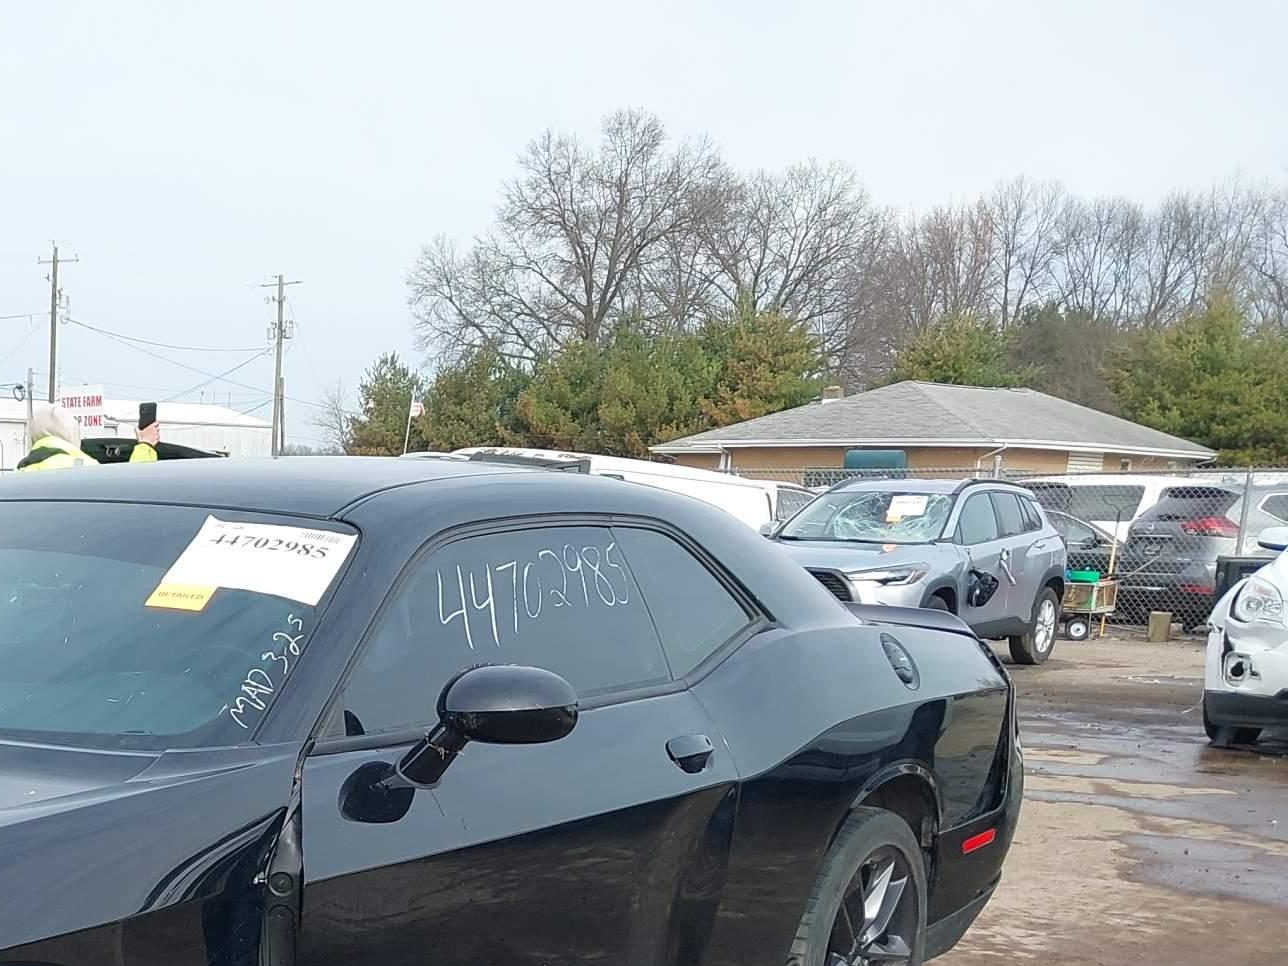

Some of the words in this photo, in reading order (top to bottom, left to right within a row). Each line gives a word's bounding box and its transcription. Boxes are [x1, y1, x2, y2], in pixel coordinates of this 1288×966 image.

[61, 397, 82, 408] STATE
[83, 396, 102, 407] FARM
[84, 416, 102, 426] ZONE
[210, 534, 330, 559] 44702985
[436, 542, 629, 650] 44702985
